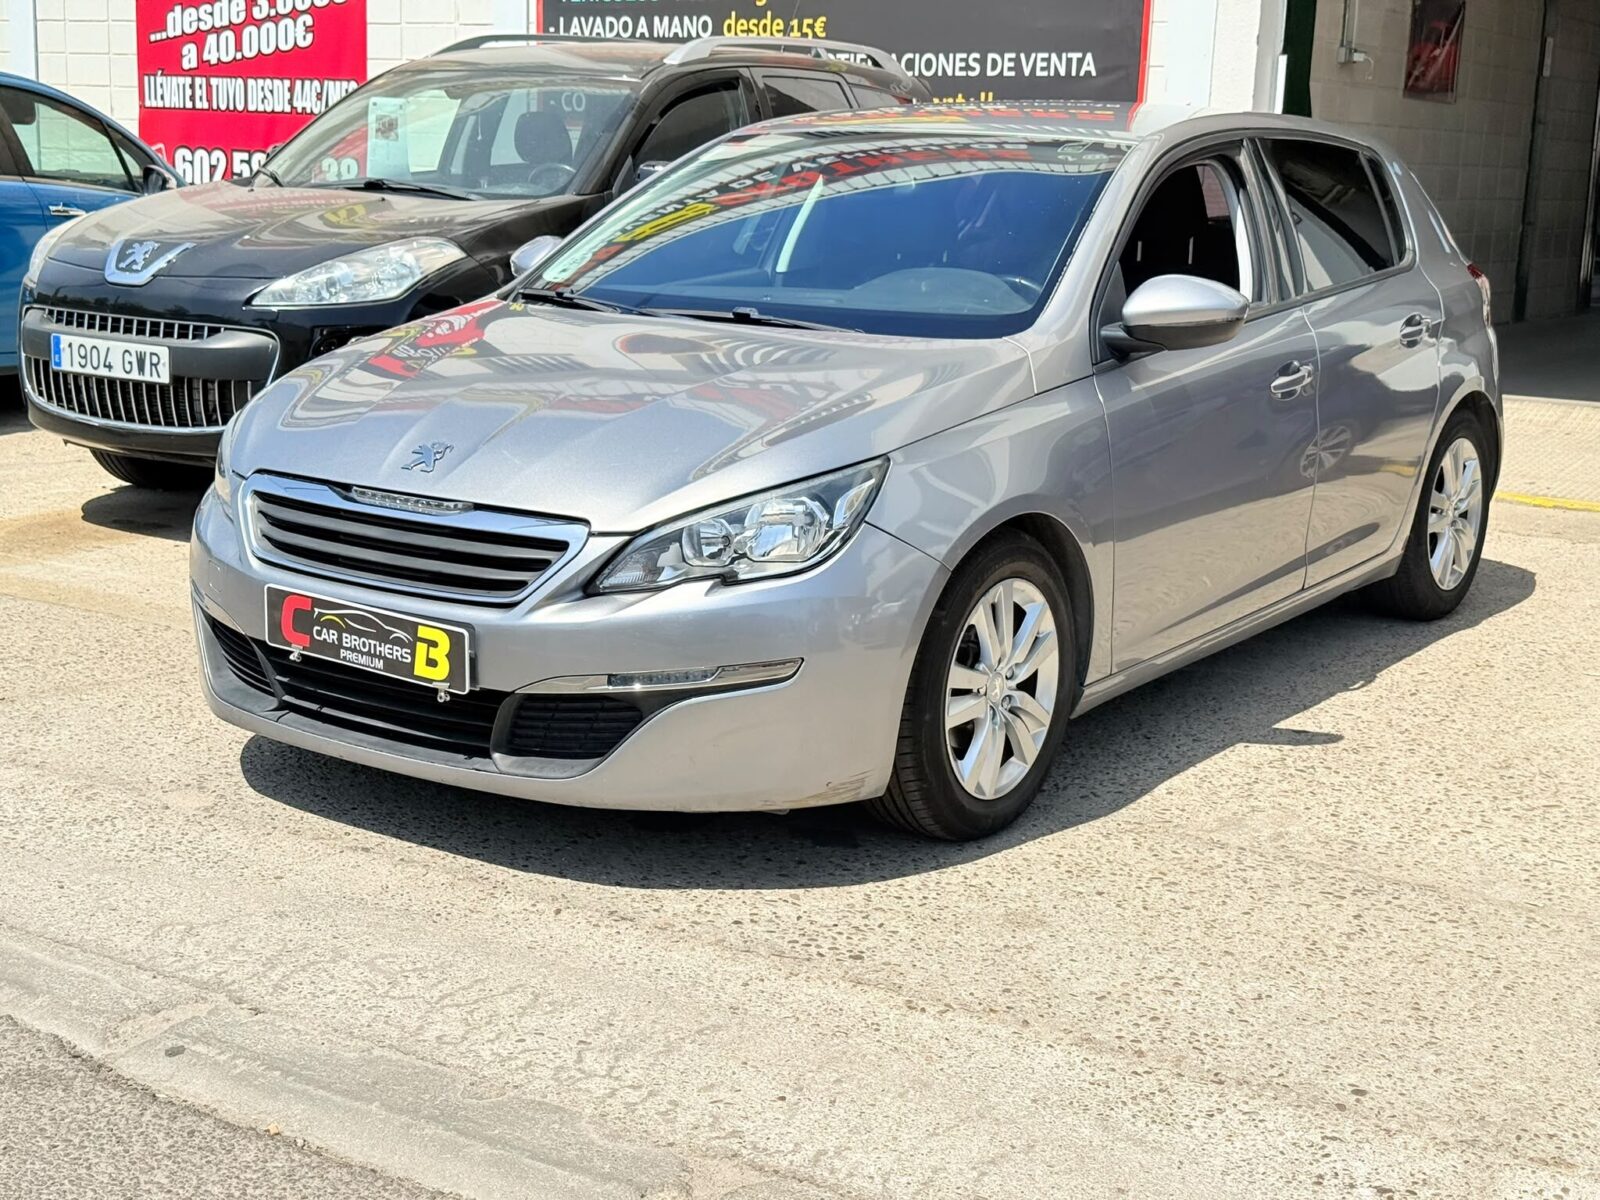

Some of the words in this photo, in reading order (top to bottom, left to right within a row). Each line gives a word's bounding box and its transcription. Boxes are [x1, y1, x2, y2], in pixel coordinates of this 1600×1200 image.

[181, 42, 198, 71] a
[202, 13, 314, 66] 40.000€
[559, 15, 632, 38] LAVADO
[635, 17, 649, 38] A
[653, 15, 713, 39] MANO
[723, 11, 784, 38] desde
[790, 16, 827, 40] 15€
[986, 53, 1014, 77] DE
[1022, 52, 1097, 77] VENTA
[143, 70, 193, 108] LLÉVATE
[194, 77, 209, 110] EL
[209, 77, 245, 112] TUYO
[247, 78, 292, 113] DESDE
[293, 79, 359, 115] 44€/M
[68, 342, 113, 372] 1904
[122, 349, 160, 378] GWR
[313, 625, 338, 645] CAR
[342, 633, 412, 663] BROTHERS
[340, 648, 384, 670] PREMIUM
